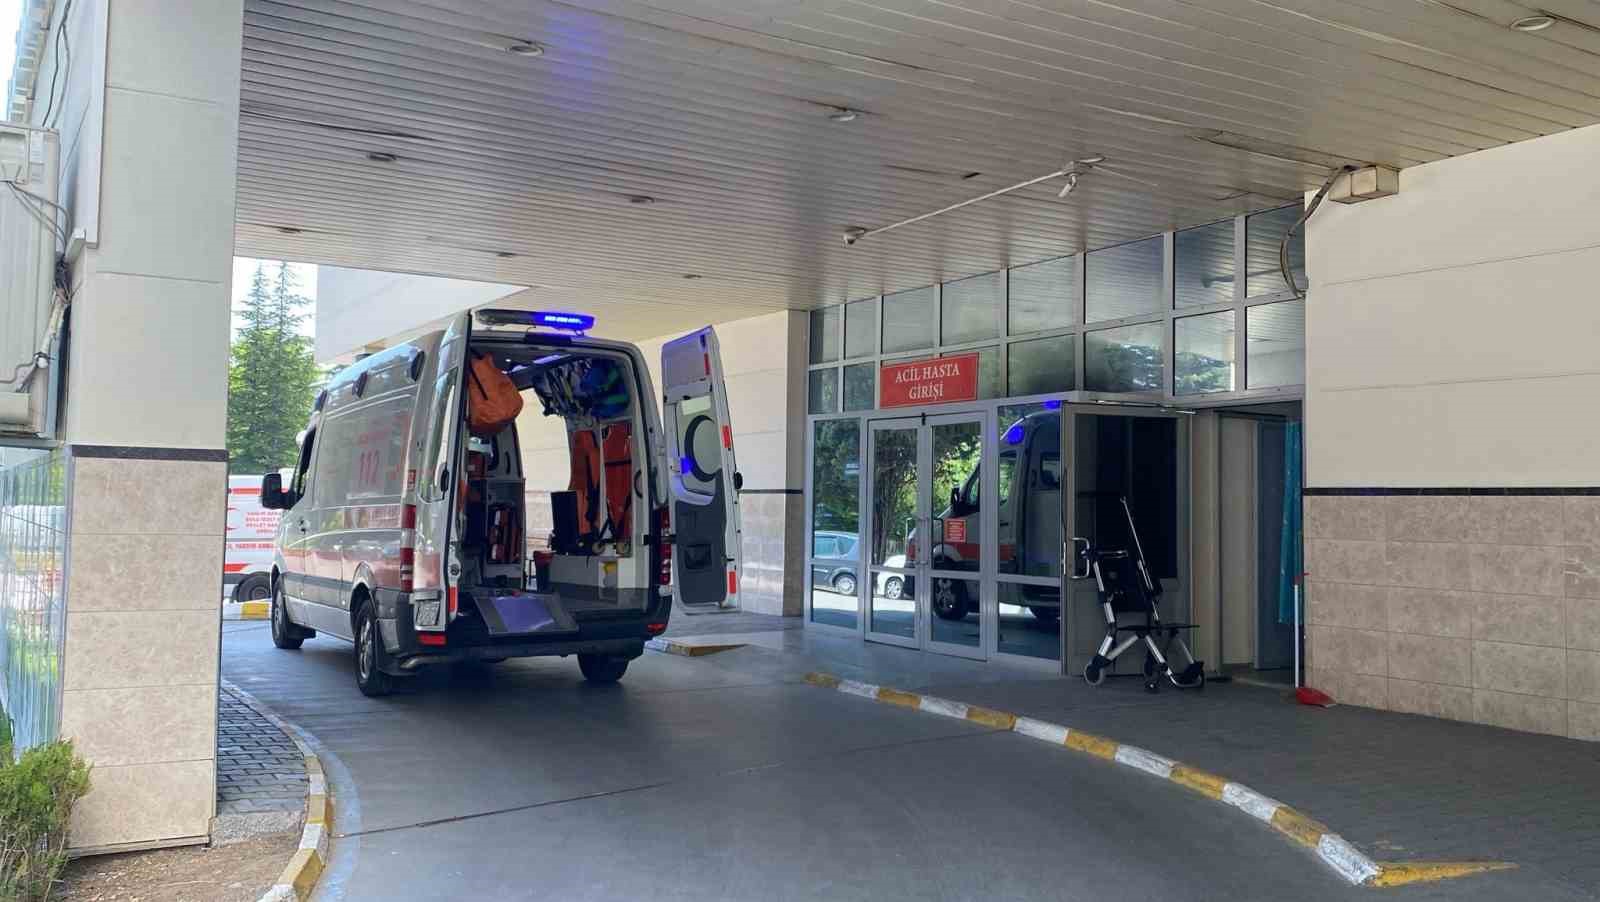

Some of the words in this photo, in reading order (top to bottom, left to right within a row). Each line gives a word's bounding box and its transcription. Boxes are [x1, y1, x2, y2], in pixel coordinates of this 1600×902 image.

[895, 366, 921, 383] ACİL
[923, 363, 960, 380] HASTA
[908, 381, 944, 400] GİRİŞİ
